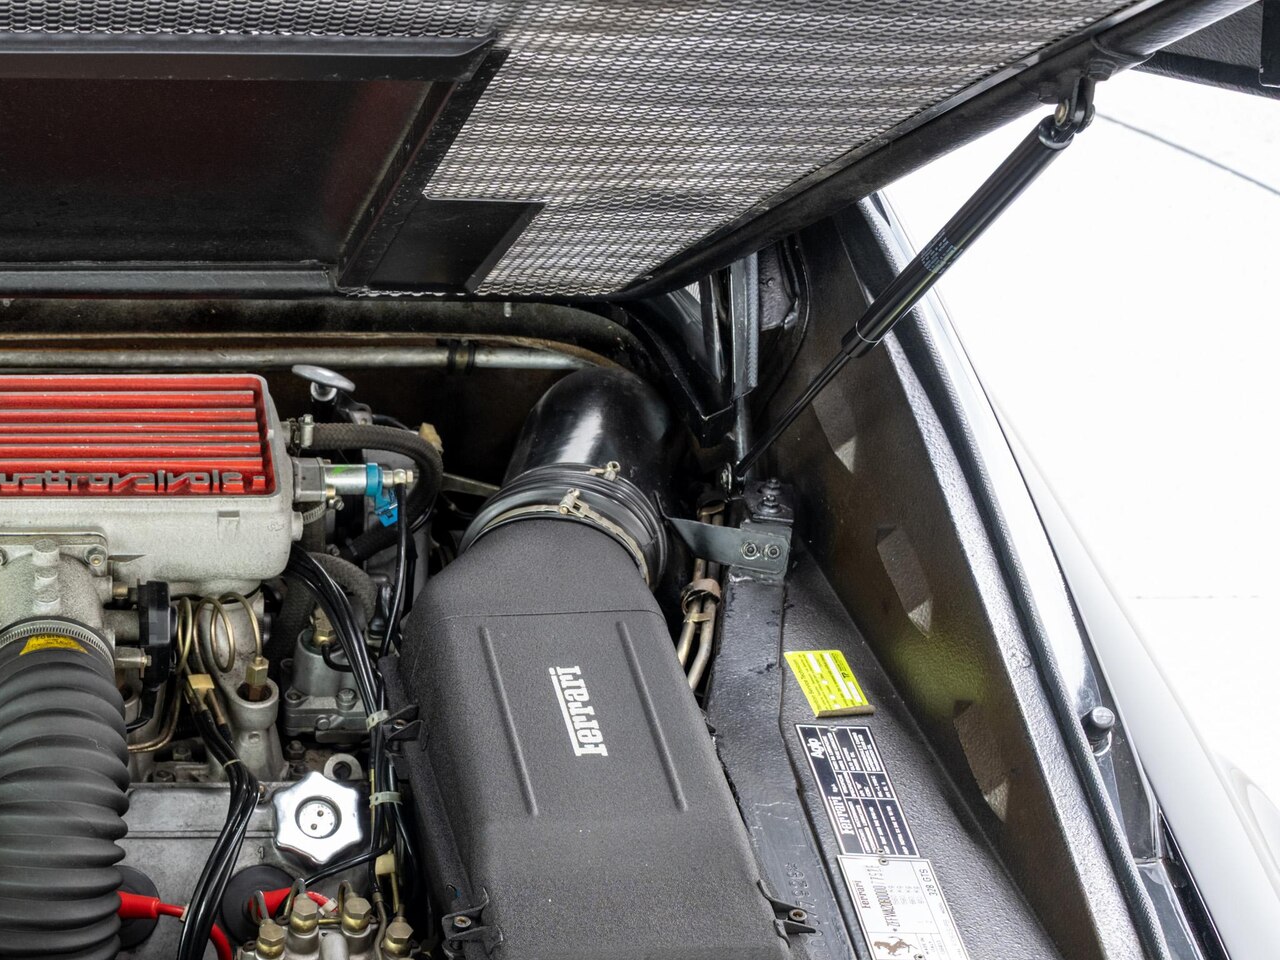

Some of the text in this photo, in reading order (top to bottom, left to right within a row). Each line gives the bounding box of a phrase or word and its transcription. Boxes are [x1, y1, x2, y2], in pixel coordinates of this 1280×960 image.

[548, 665, 609, 757] Ferrari
[807, 737, 825, 759] Agip
[919, 868, 938, 897] 328 GTS
